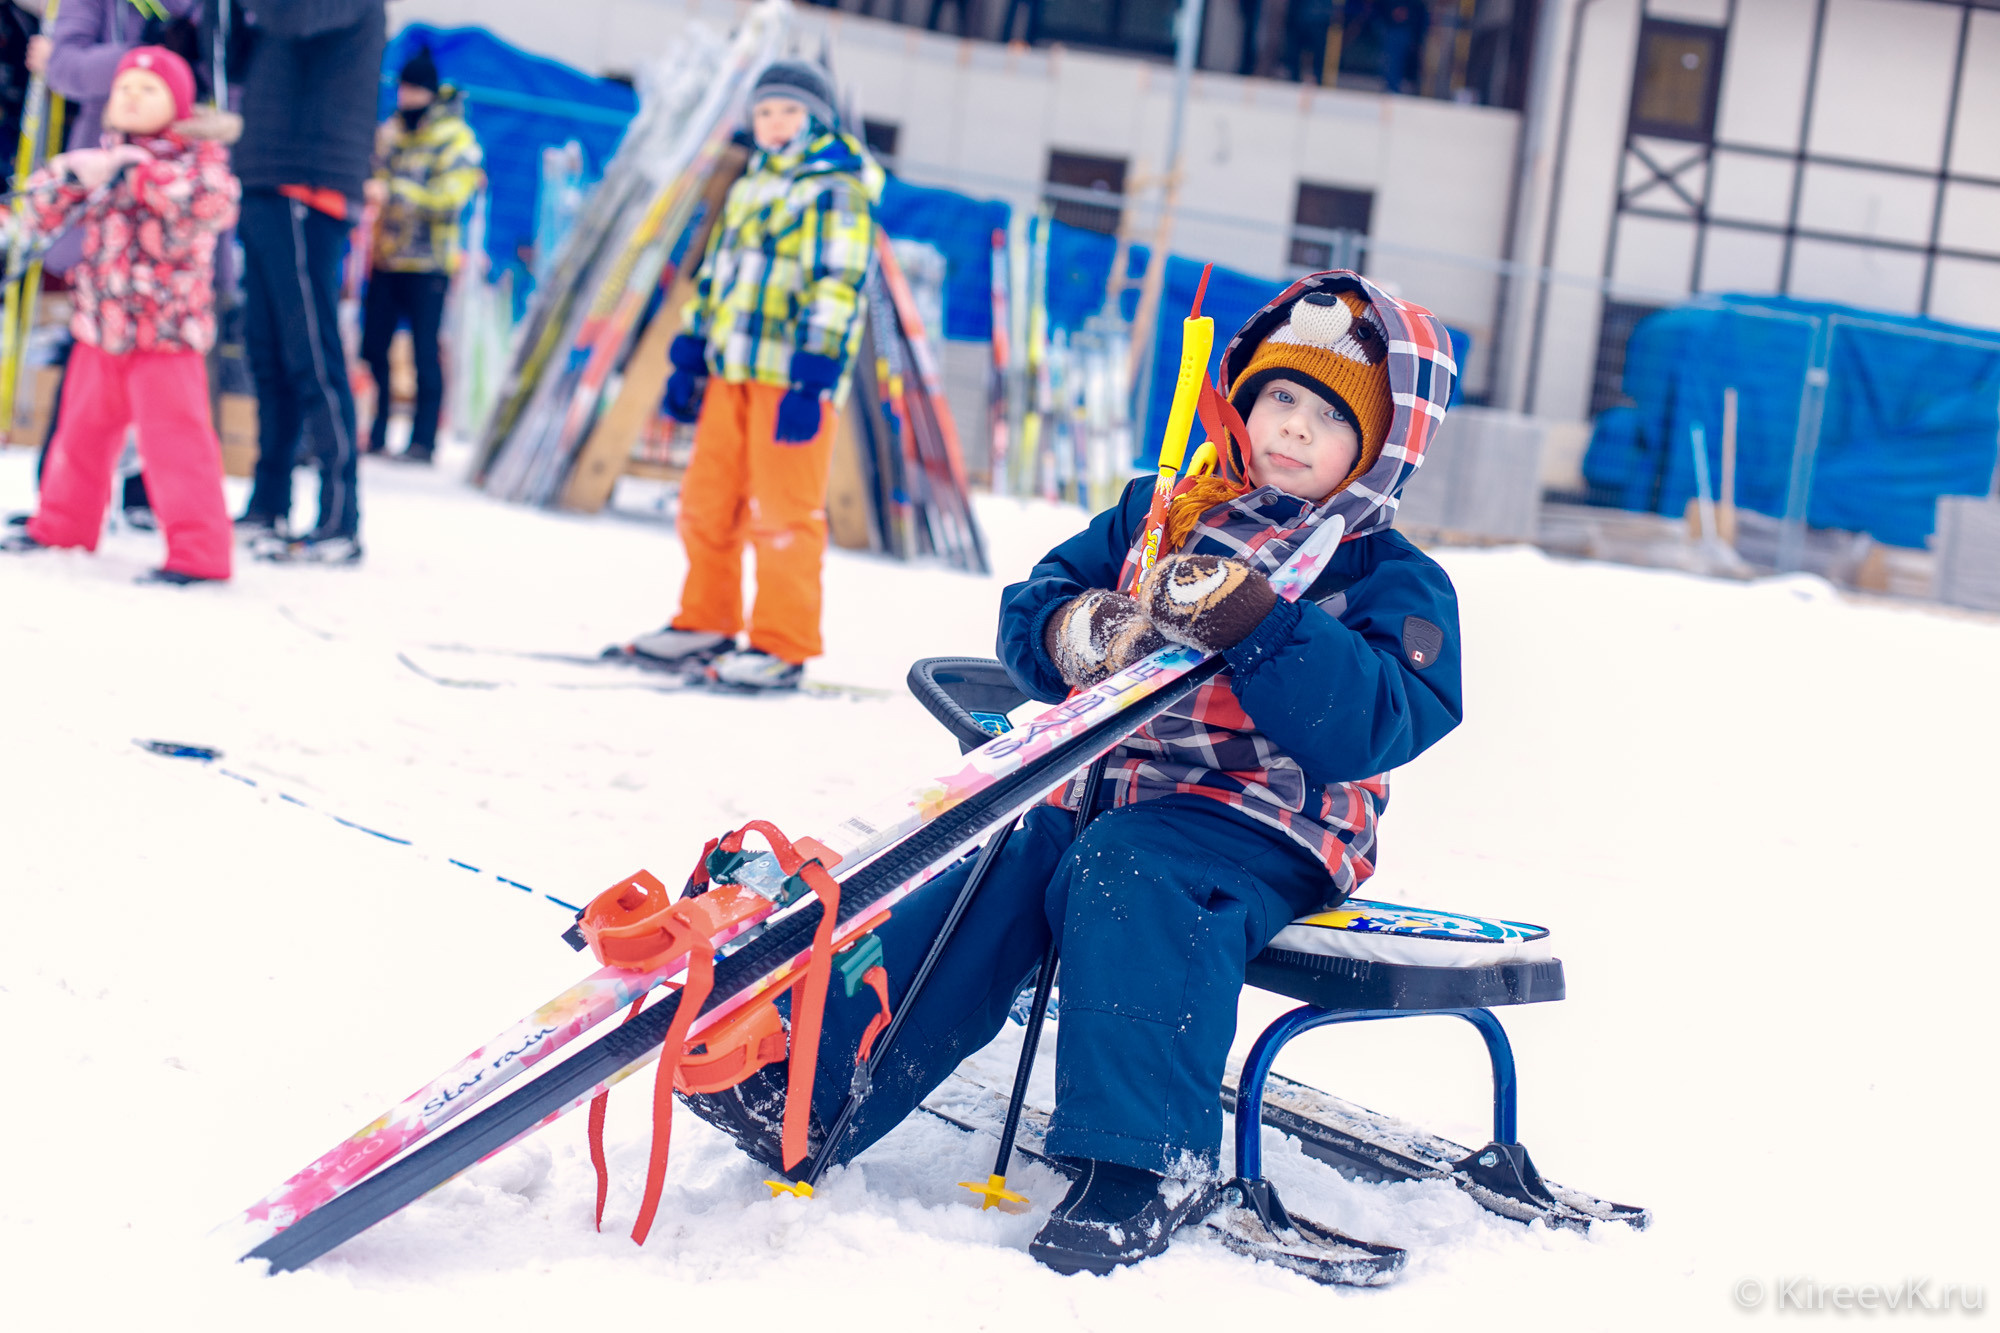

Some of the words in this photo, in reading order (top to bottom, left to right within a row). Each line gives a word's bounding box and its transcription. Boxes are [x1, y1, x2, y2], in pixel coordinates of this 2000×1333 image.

[983, 662, 1165, 760] SABLE
[423, 1067, 486, 1118] Star
[493, 1025, 558, 1069] rain
[334, 1137, 384, 1174] 120
